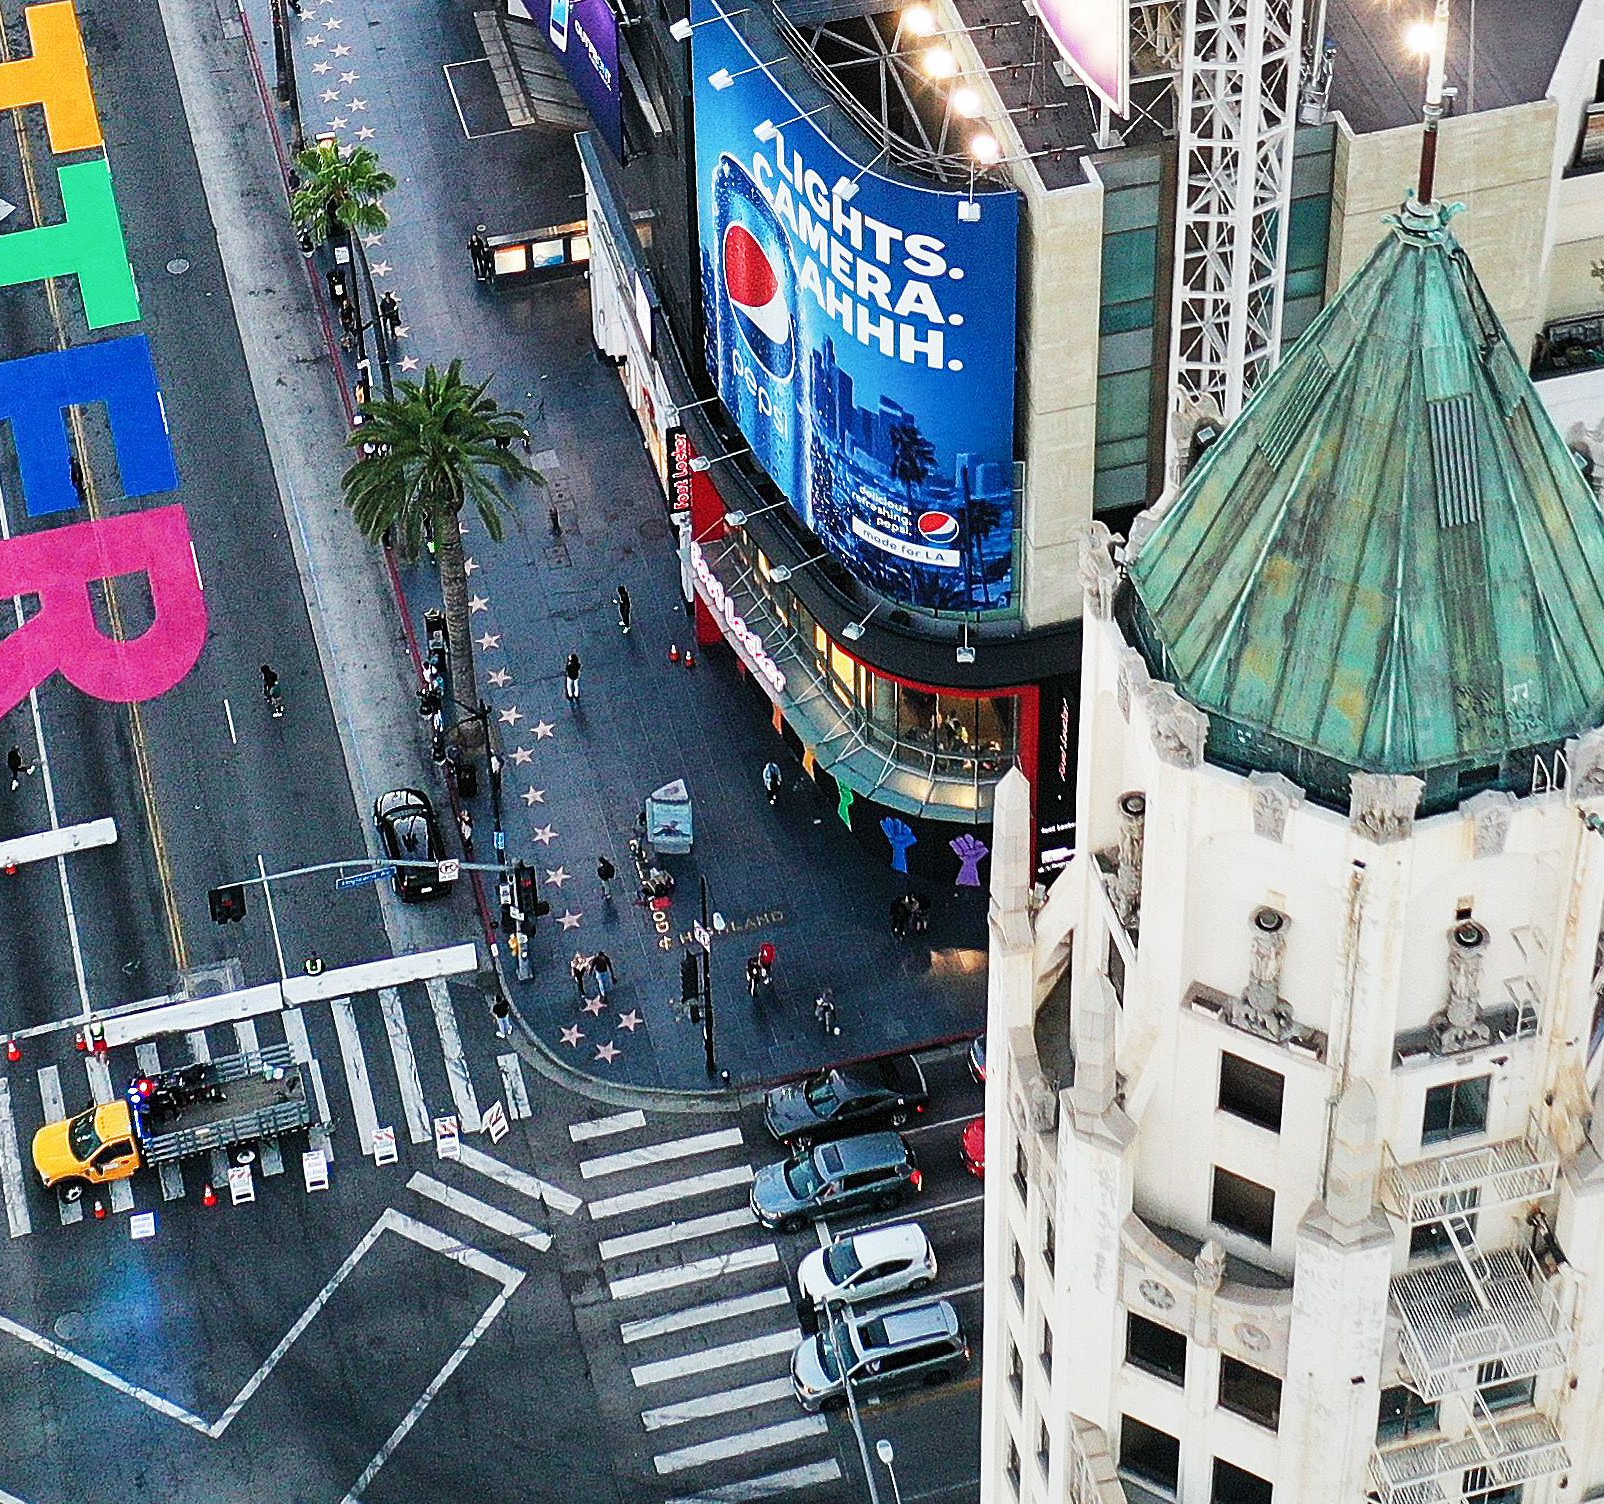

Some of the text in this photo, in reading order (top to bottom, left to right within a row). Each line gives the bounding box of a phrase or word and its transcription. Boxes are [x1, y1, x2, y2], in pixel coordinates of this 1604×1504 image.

[752, 151, 965, 326] CAMERA.
[773, 128, 965, 280] LIGHTS.
[798, 255, 965, 372] AHHH.
[732, 348, 789, 443] pepsi
[671, 433, 690, 511] Foot Locker
[851, 490, 913, 527] refreshing.
[859, 485, 912, 516] delicious.
[862, 529, 946, 562] made for LA
[876, 516, 913, 537] pepsi.
[690, 540, 787, 693] Foot Locker
